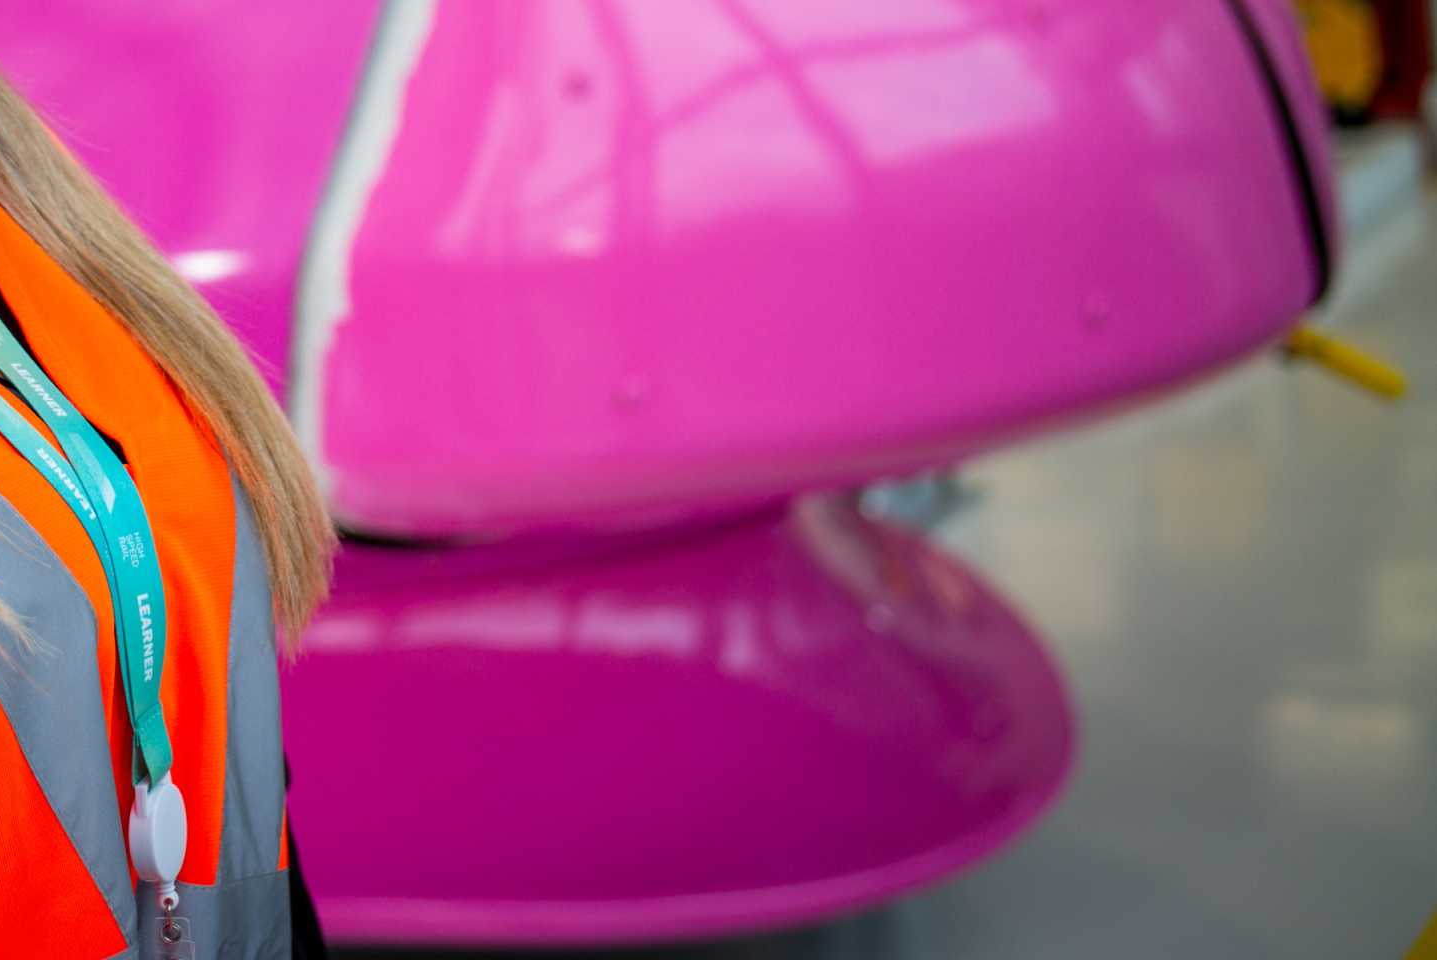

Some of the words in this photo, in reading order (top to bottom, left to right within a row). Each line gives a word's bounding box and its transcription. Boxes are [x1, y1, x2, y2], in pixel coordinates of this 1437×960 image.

[10, 362, 68, 417] LEARNER
[36, 447, 97, 520] LEARNER
[125, 534, 140, 568] SPEED
[137, 592, 154, 682] LEARNER
